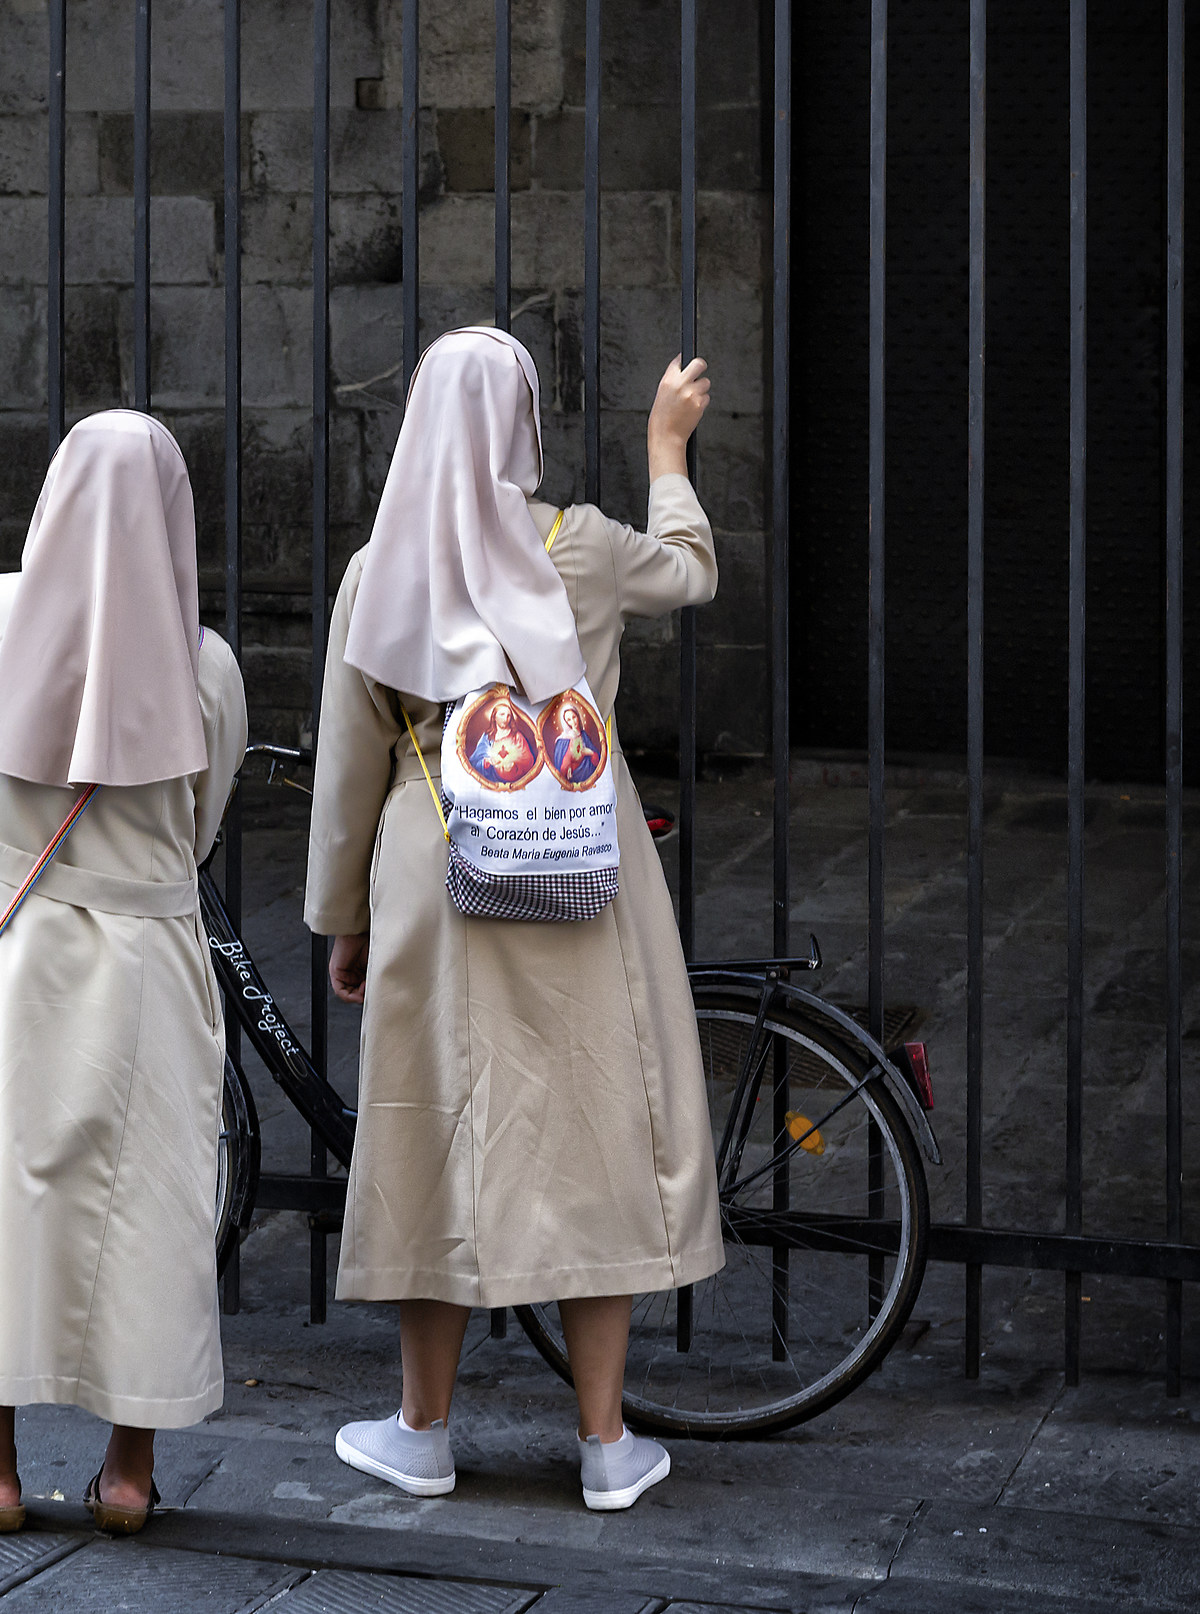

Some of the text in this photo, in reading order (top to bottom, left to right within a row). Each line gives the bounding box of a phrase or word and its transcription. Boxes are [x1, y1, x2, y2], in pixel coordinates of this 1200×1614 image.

[526, 806, 537, 820] el
[544, 806, 566, 820] bien
[569, 807, 586, 822] por
[486, 826, 539, 841] Corazón
[542, 827, 556, 840] de
[481, 845, 509, 859] Beata
[542, 846, 580, 861] Eugenia
[581, 843, 612, 857] Ravasco
[208, 936, 300, 1057] Bike Project
